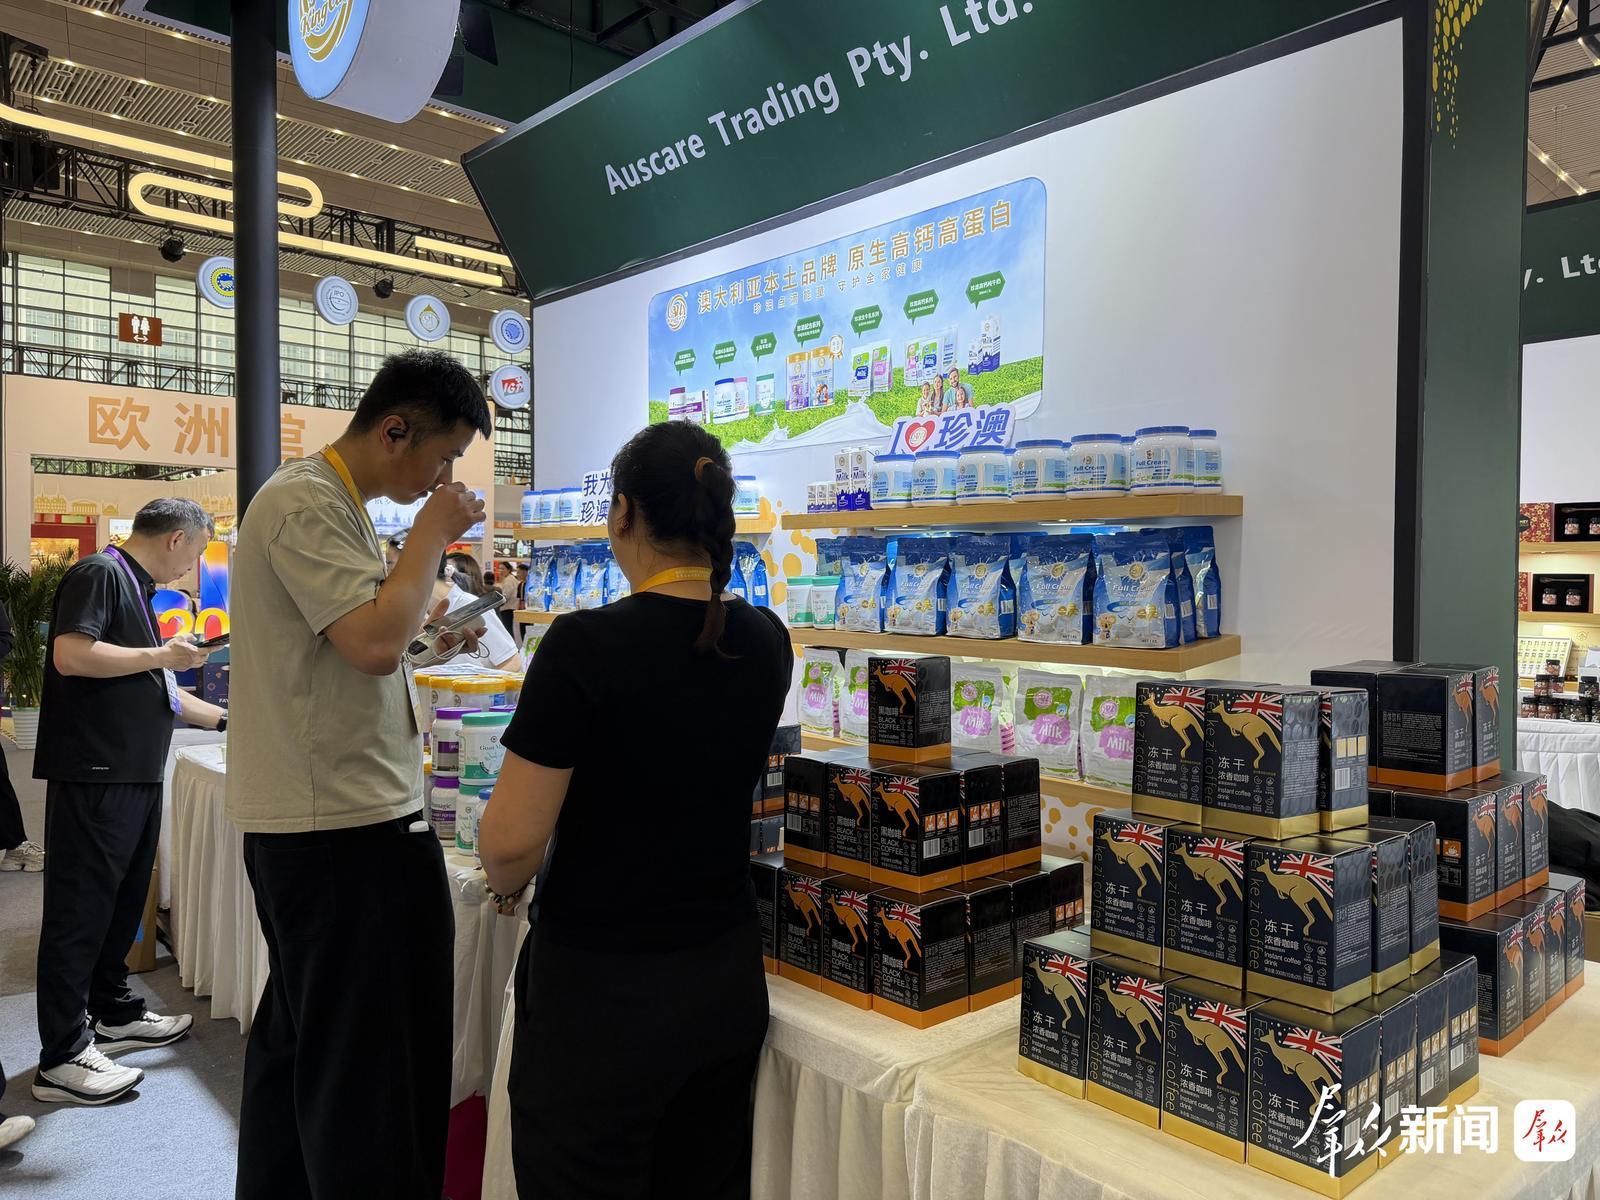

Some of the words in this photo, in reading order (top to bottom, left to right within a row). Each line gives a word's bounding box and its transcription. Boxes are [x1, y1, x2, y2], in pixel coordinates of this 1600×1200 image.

[604, 133, 706, 195] Auscare
[708, 72, 840, 147] Trading
[847, 34, 929, 87] Pty.
[697, 254, 838, 314] 澳大利亚本土品牌
[848, 201, 1012, 272] 原生高钙高蛋白
[933, 408, 1010, 450] 珍澳
[580, 499, 610, 523] 珍澳
[966, 714, 985, 729] Milk
[1039, 724, 1063, 739] Milk
[1107, 736, 1134, 753] Milk
[1147, 745, 1173, 759] 冻干
[1147, 760, 1177, 771] 浓香咖啡
[1217, 756, 1245, 771] 冻干
[1218, 771, 1250, 783] 浓香咖啡
[1105, 881, 1130, 898] 冻干
[1105, 895, 1135, 911] 浓香咖啡
[1180, 899, 1208, 915] 冻干
[1180, 913, 1213, 929] 浓香咖啡
[1264, 919, 1294, 936] 冻干
[1264, 934, 1300, 951] 浓香咖啡
[882, 966, 901, 979] BLACK
[882, 975, 905, 988] COFFEE
[1033, 1010, 1056, 1028] 冻干
[1032, 1025, 1060, 1040] 浓香咖啡
[1103, 1033, 1128, 1053] 冻干
[1102, 1048, 1133, 1067] 浓香咖啡
[1180, 1062, 1208, 1083] 冻干
[1180, 1077, 1213, 1098] 浓香咖啡
[1268, 1091, 1300, 1114] 冻干
[1268, 1109, 1305, 1130] 浓香咖啡
